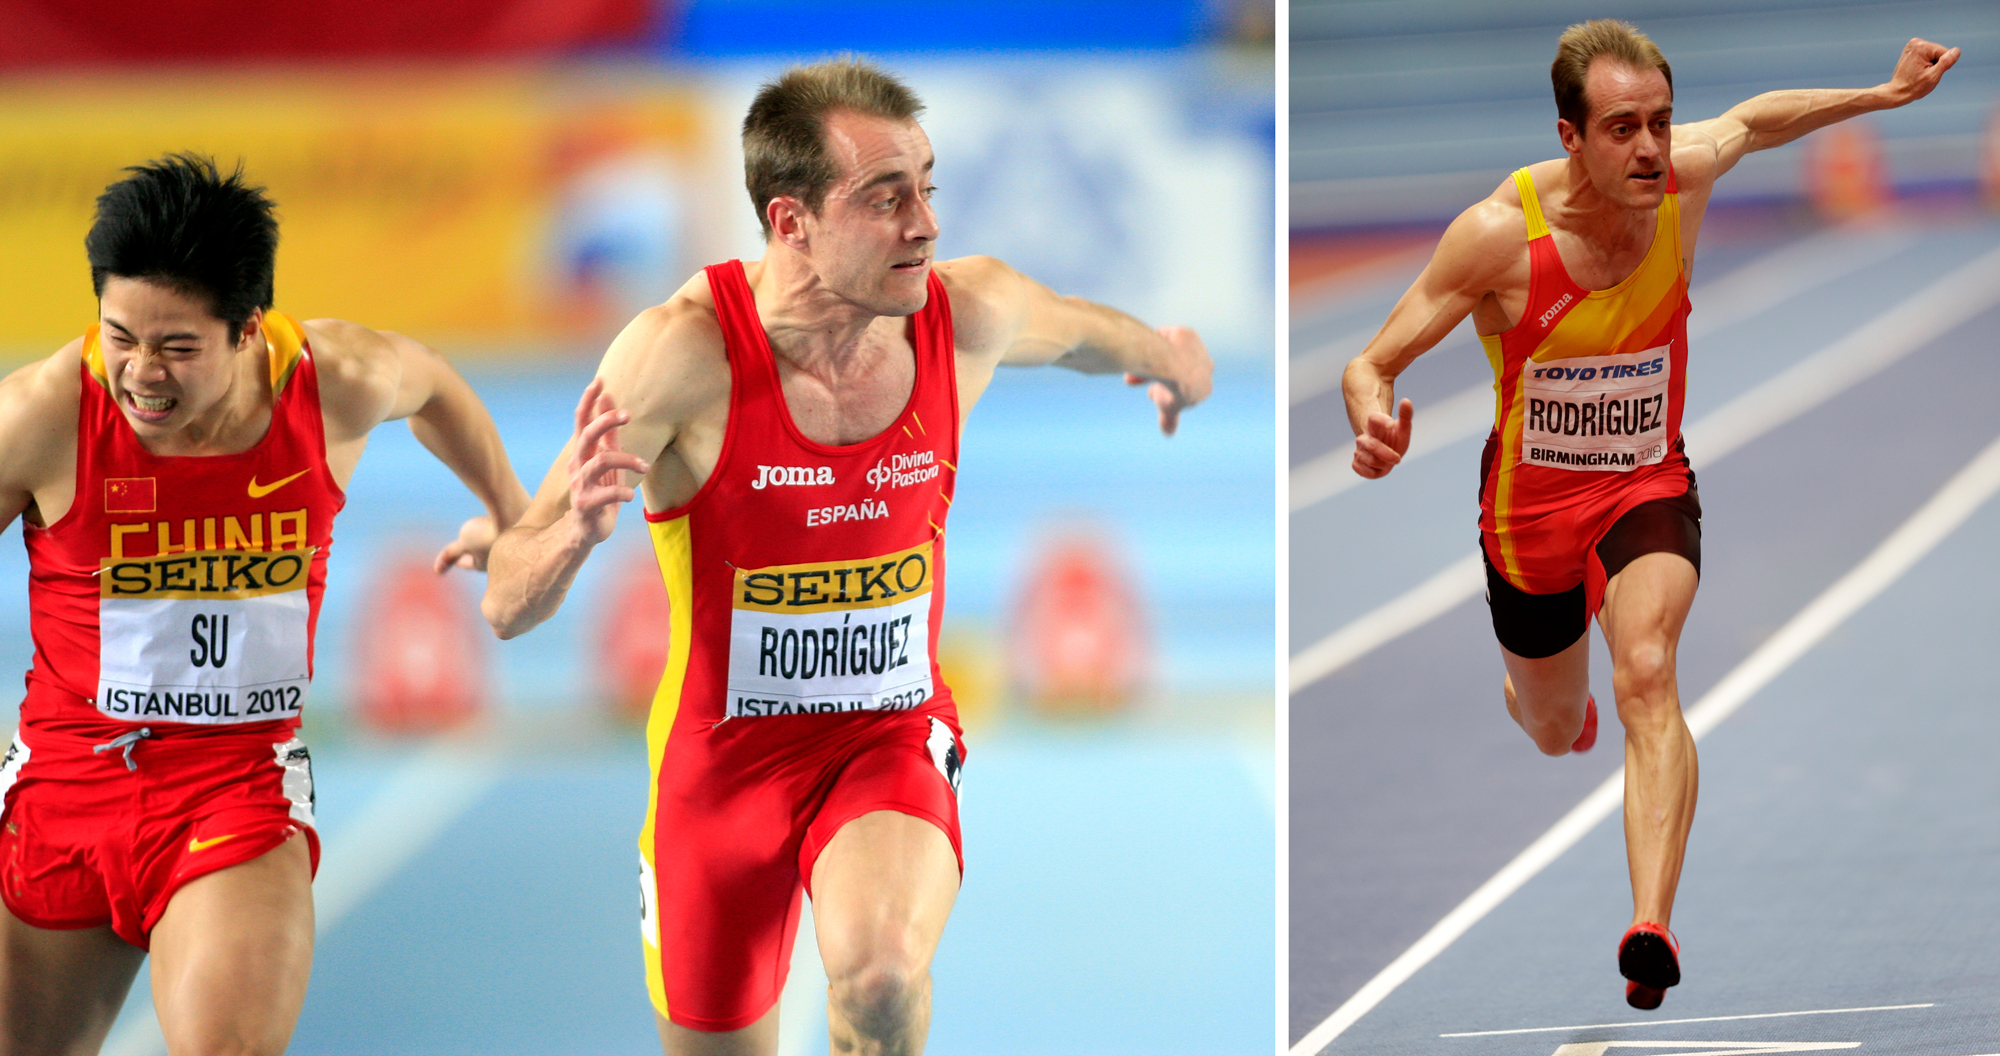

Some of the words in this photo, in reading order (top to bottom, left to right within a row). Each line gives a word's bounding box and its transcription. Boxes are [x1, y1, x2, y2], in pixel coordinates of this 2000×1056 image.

[1533, 366, 1596, 381] TOYO
[1600, 357, 1664, 379] TIRES
[1529, 393, 1664, 437] RODRÍGUEZ
[891, 450, 935, 473] Divina
[1530, 447, 1636, 466] BIRMINGHAM
[1636, 444, 1662, 464] 2018
[891, 464, 940, 489] Pastora
[806, 498, 890, 527] ESPAÑA
[110, 555, 302, 594] SEIKO
[743, 553, 927, 607] SEIKO
[190, 613, 229, 669] SU
[758, 612, 913, 680] RODRÍGUEZ
[105, 687, 239, 717] ISTANBUL
[245, 686, 302, 716] 2012
